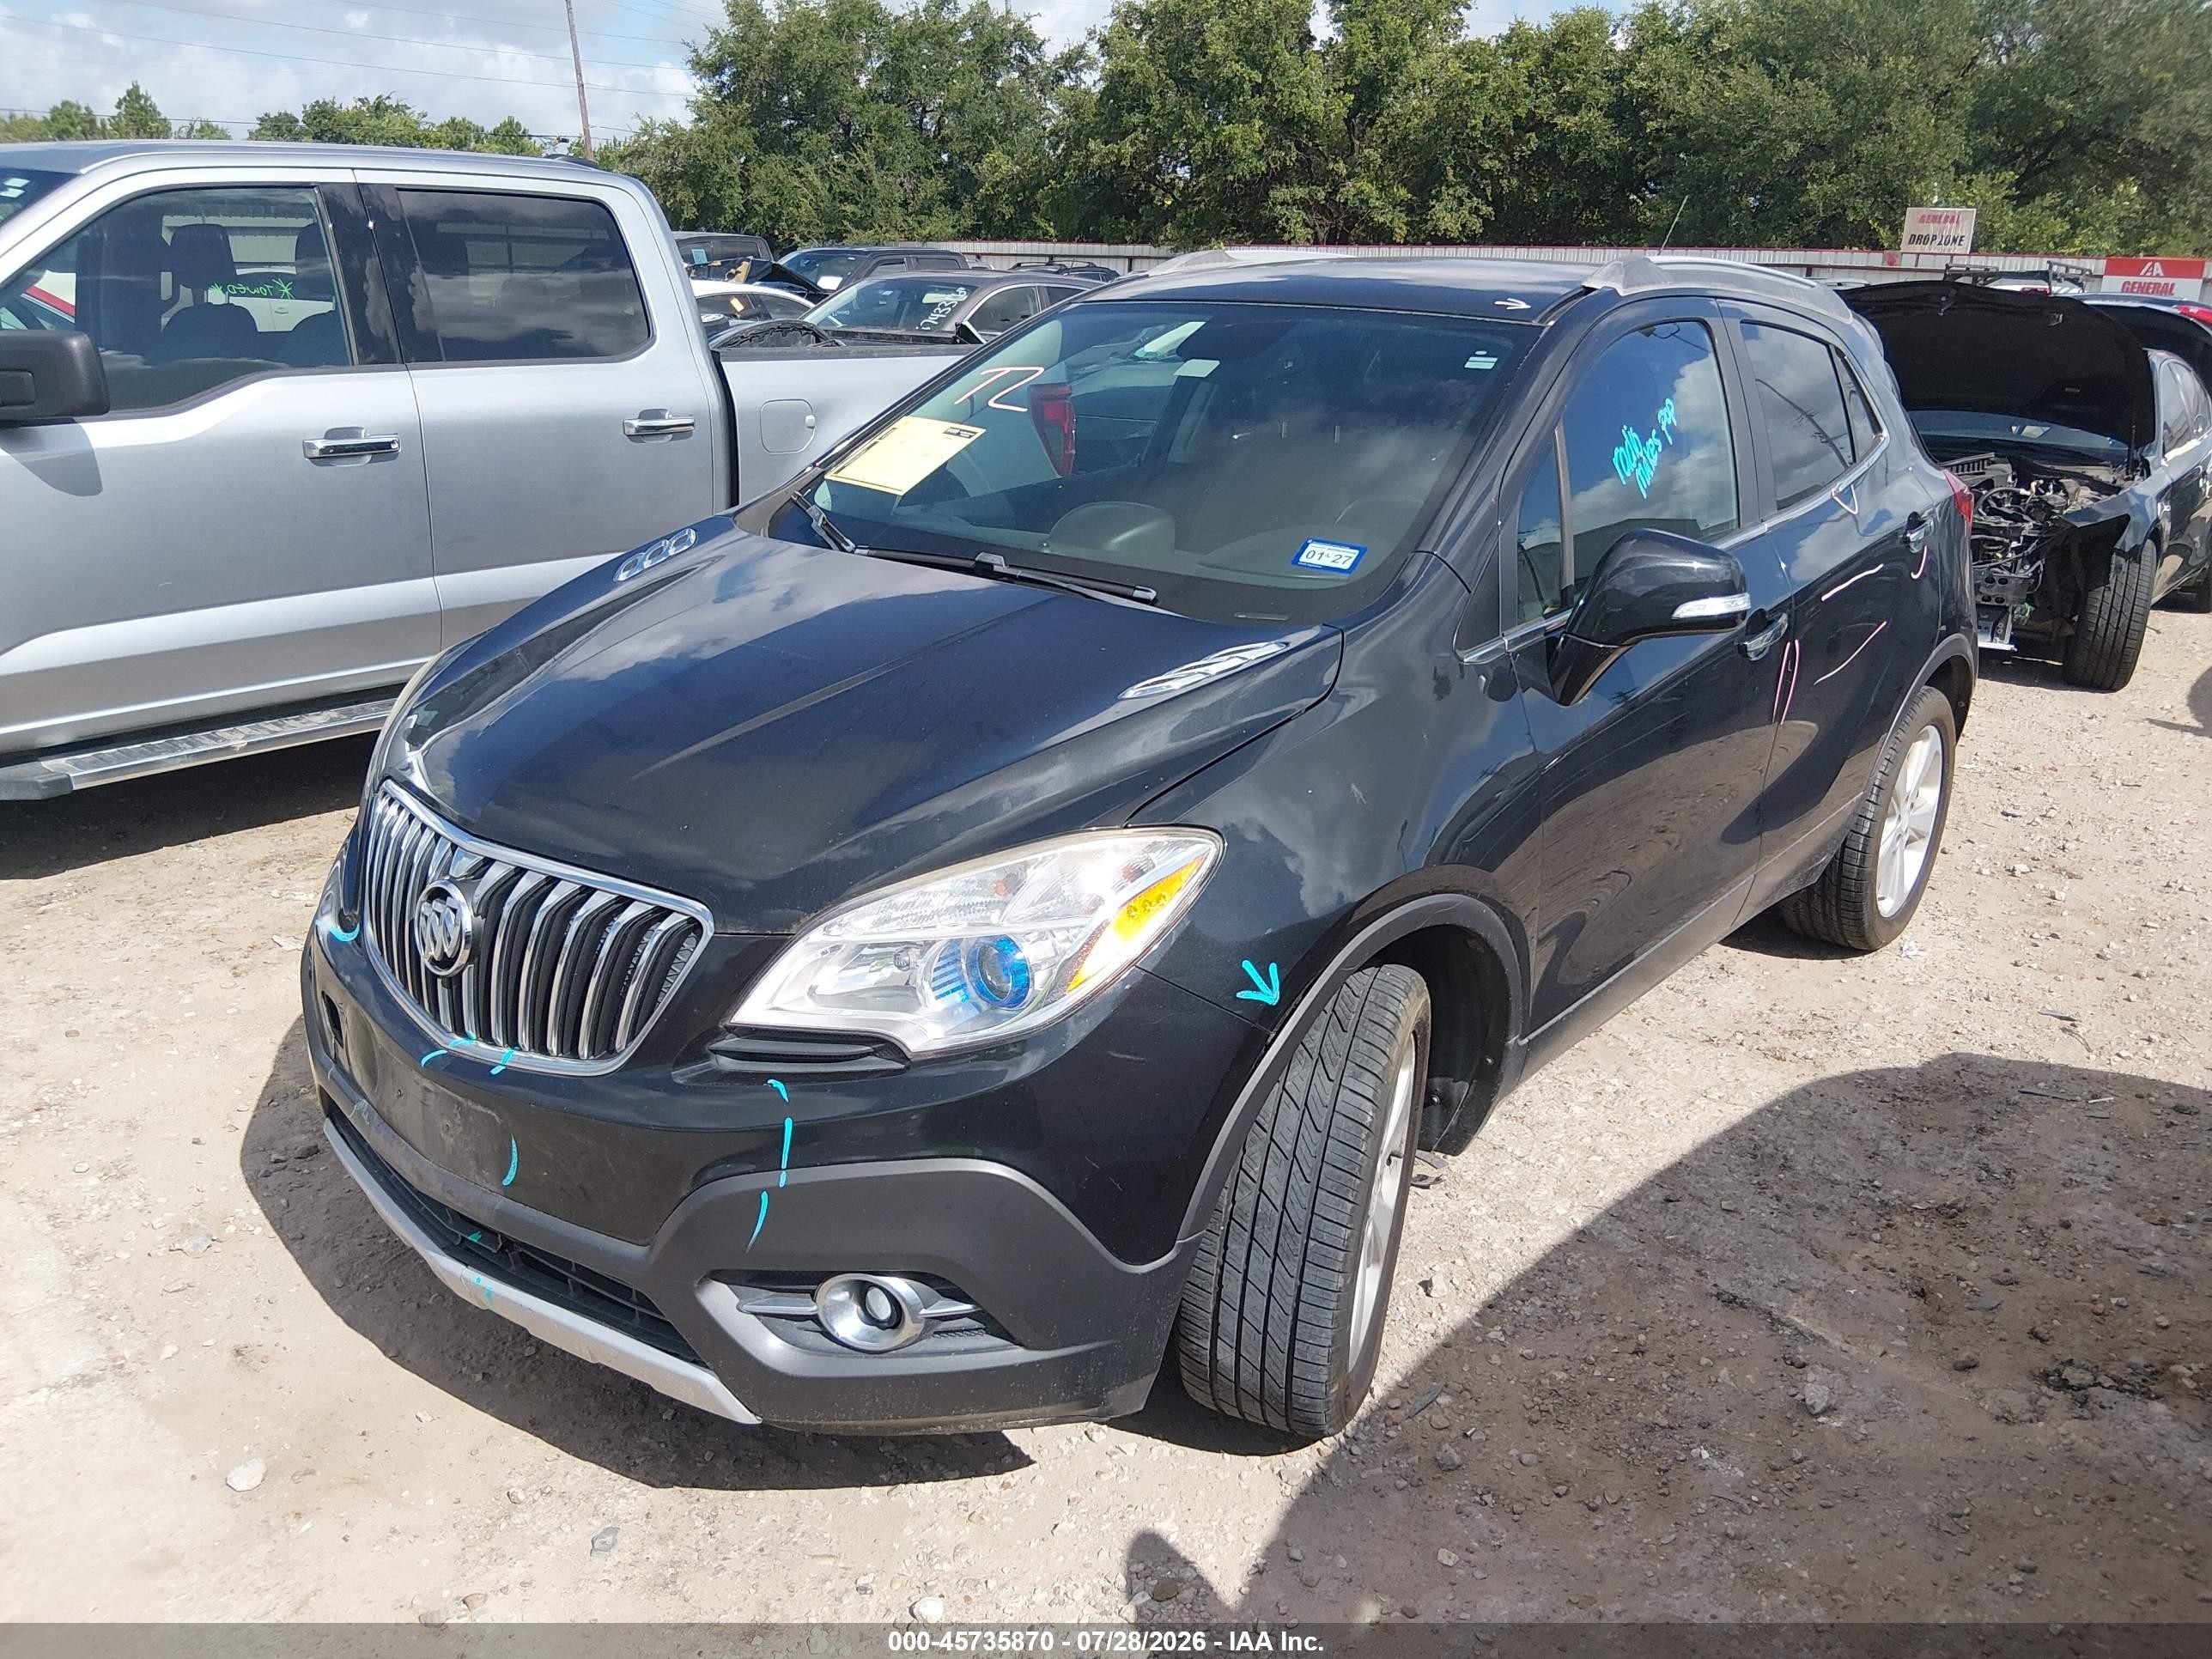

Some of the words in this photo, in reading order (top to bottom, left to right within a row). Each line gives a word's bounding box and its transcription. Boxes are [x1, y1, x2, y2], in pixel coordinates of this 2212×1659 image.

[1918, 213, 1961, 224] GENERAL
[1908, 234, 1936, 246] DROP
[1937, 234, 1966, 246] ZONE
[2121, 280, 2176, 295] GENERAL
